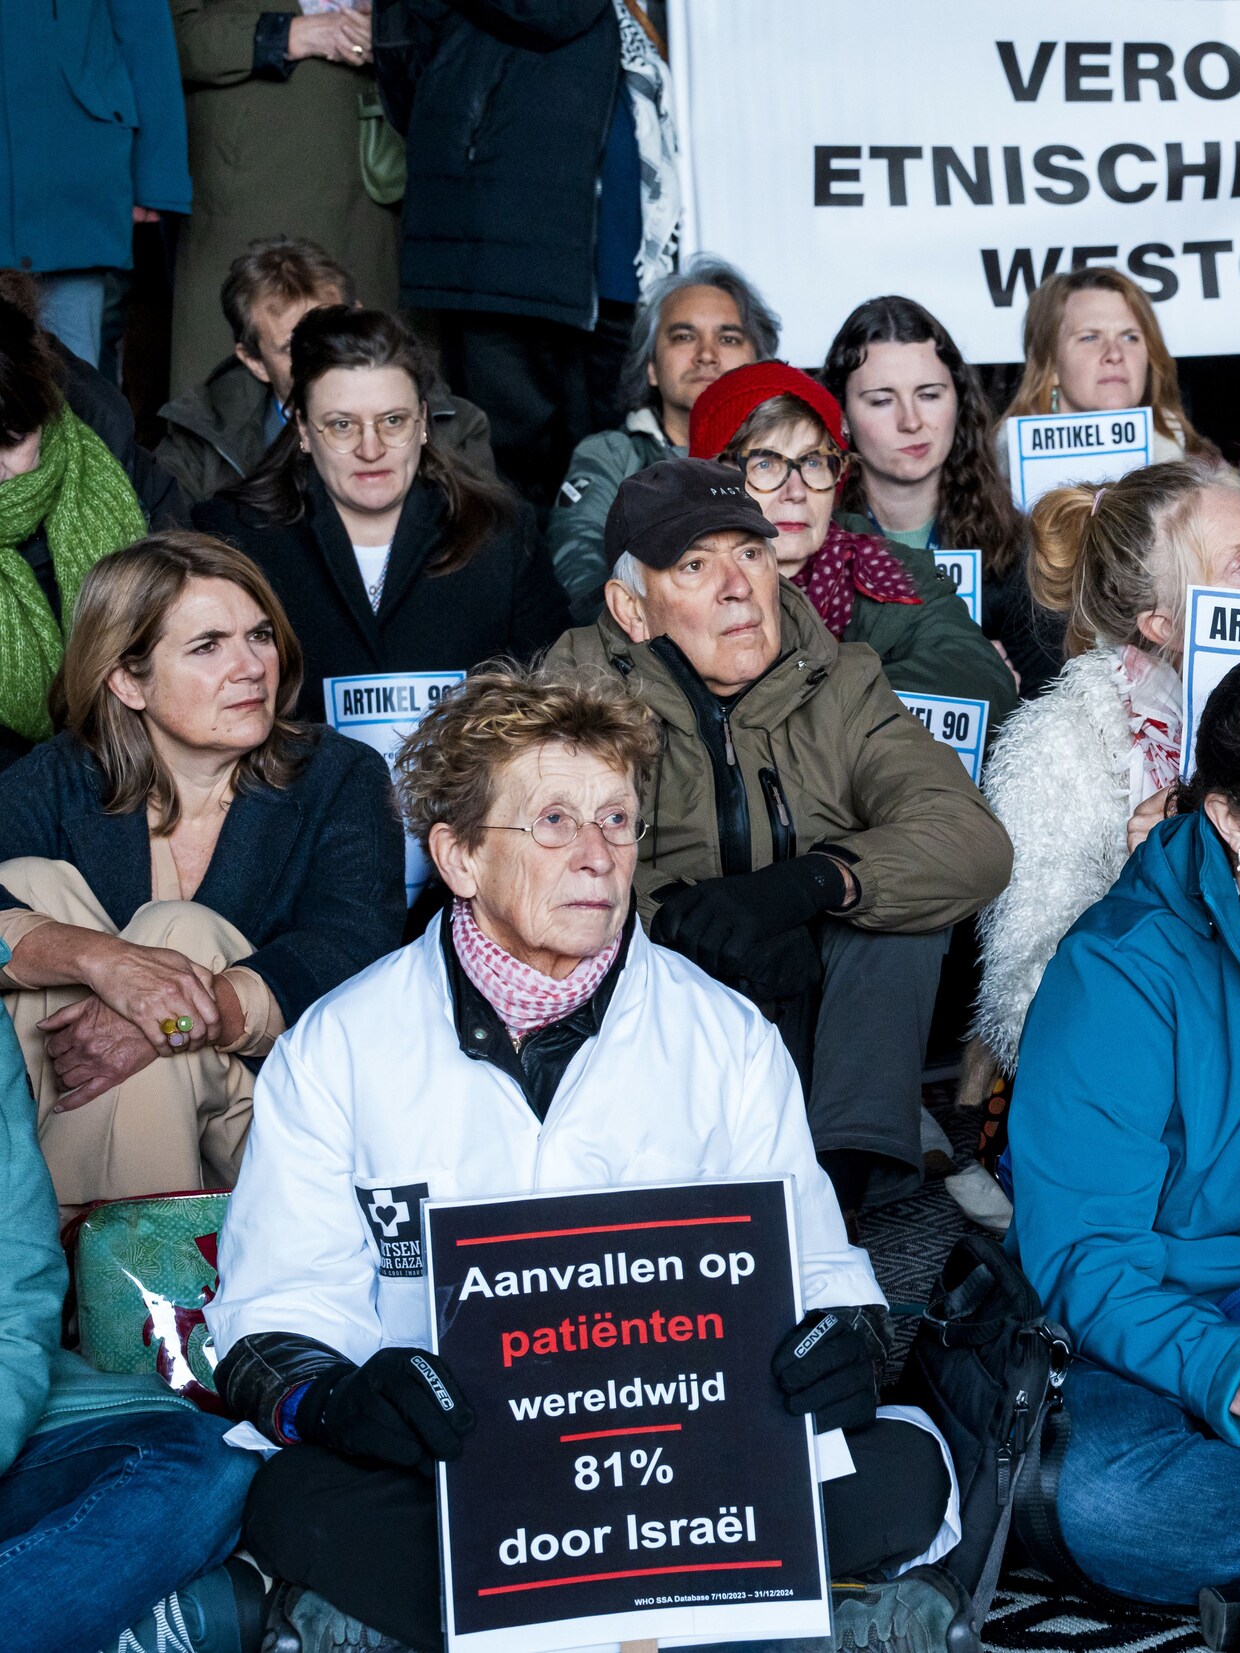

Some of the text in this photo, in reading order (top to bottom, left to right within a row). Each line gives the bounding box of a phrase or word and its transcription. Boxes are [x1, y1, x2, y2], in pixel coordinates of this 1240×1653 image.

[1031, 421, 1136, 451] ARTIKEL 90
[343, 686, 420, 716] ARTIKEL
[942, 711, 970, 742] 90
[382, 1240, 420, 1257] TSEN
[394, 1256, 423, 1269] GAZA
[458, 1251, 755, 1300] Aanvallen op
[501, 1309, 724, 1367] patiënten
[508, 1372, 726, 1421] wereldwijd
[574, 1447, 674, 1491] 81%
[498, 1506, 756, 1565] door Israël
[634, 1598, 655, 1606] WHO
[656, 1596, 673, 1604] SSA
[674, 1593, 710, 1603] Database
[711, 1591, 746, 1600] 7/10/2023
[754, 1589, 794, 1598] 31/12/2024
